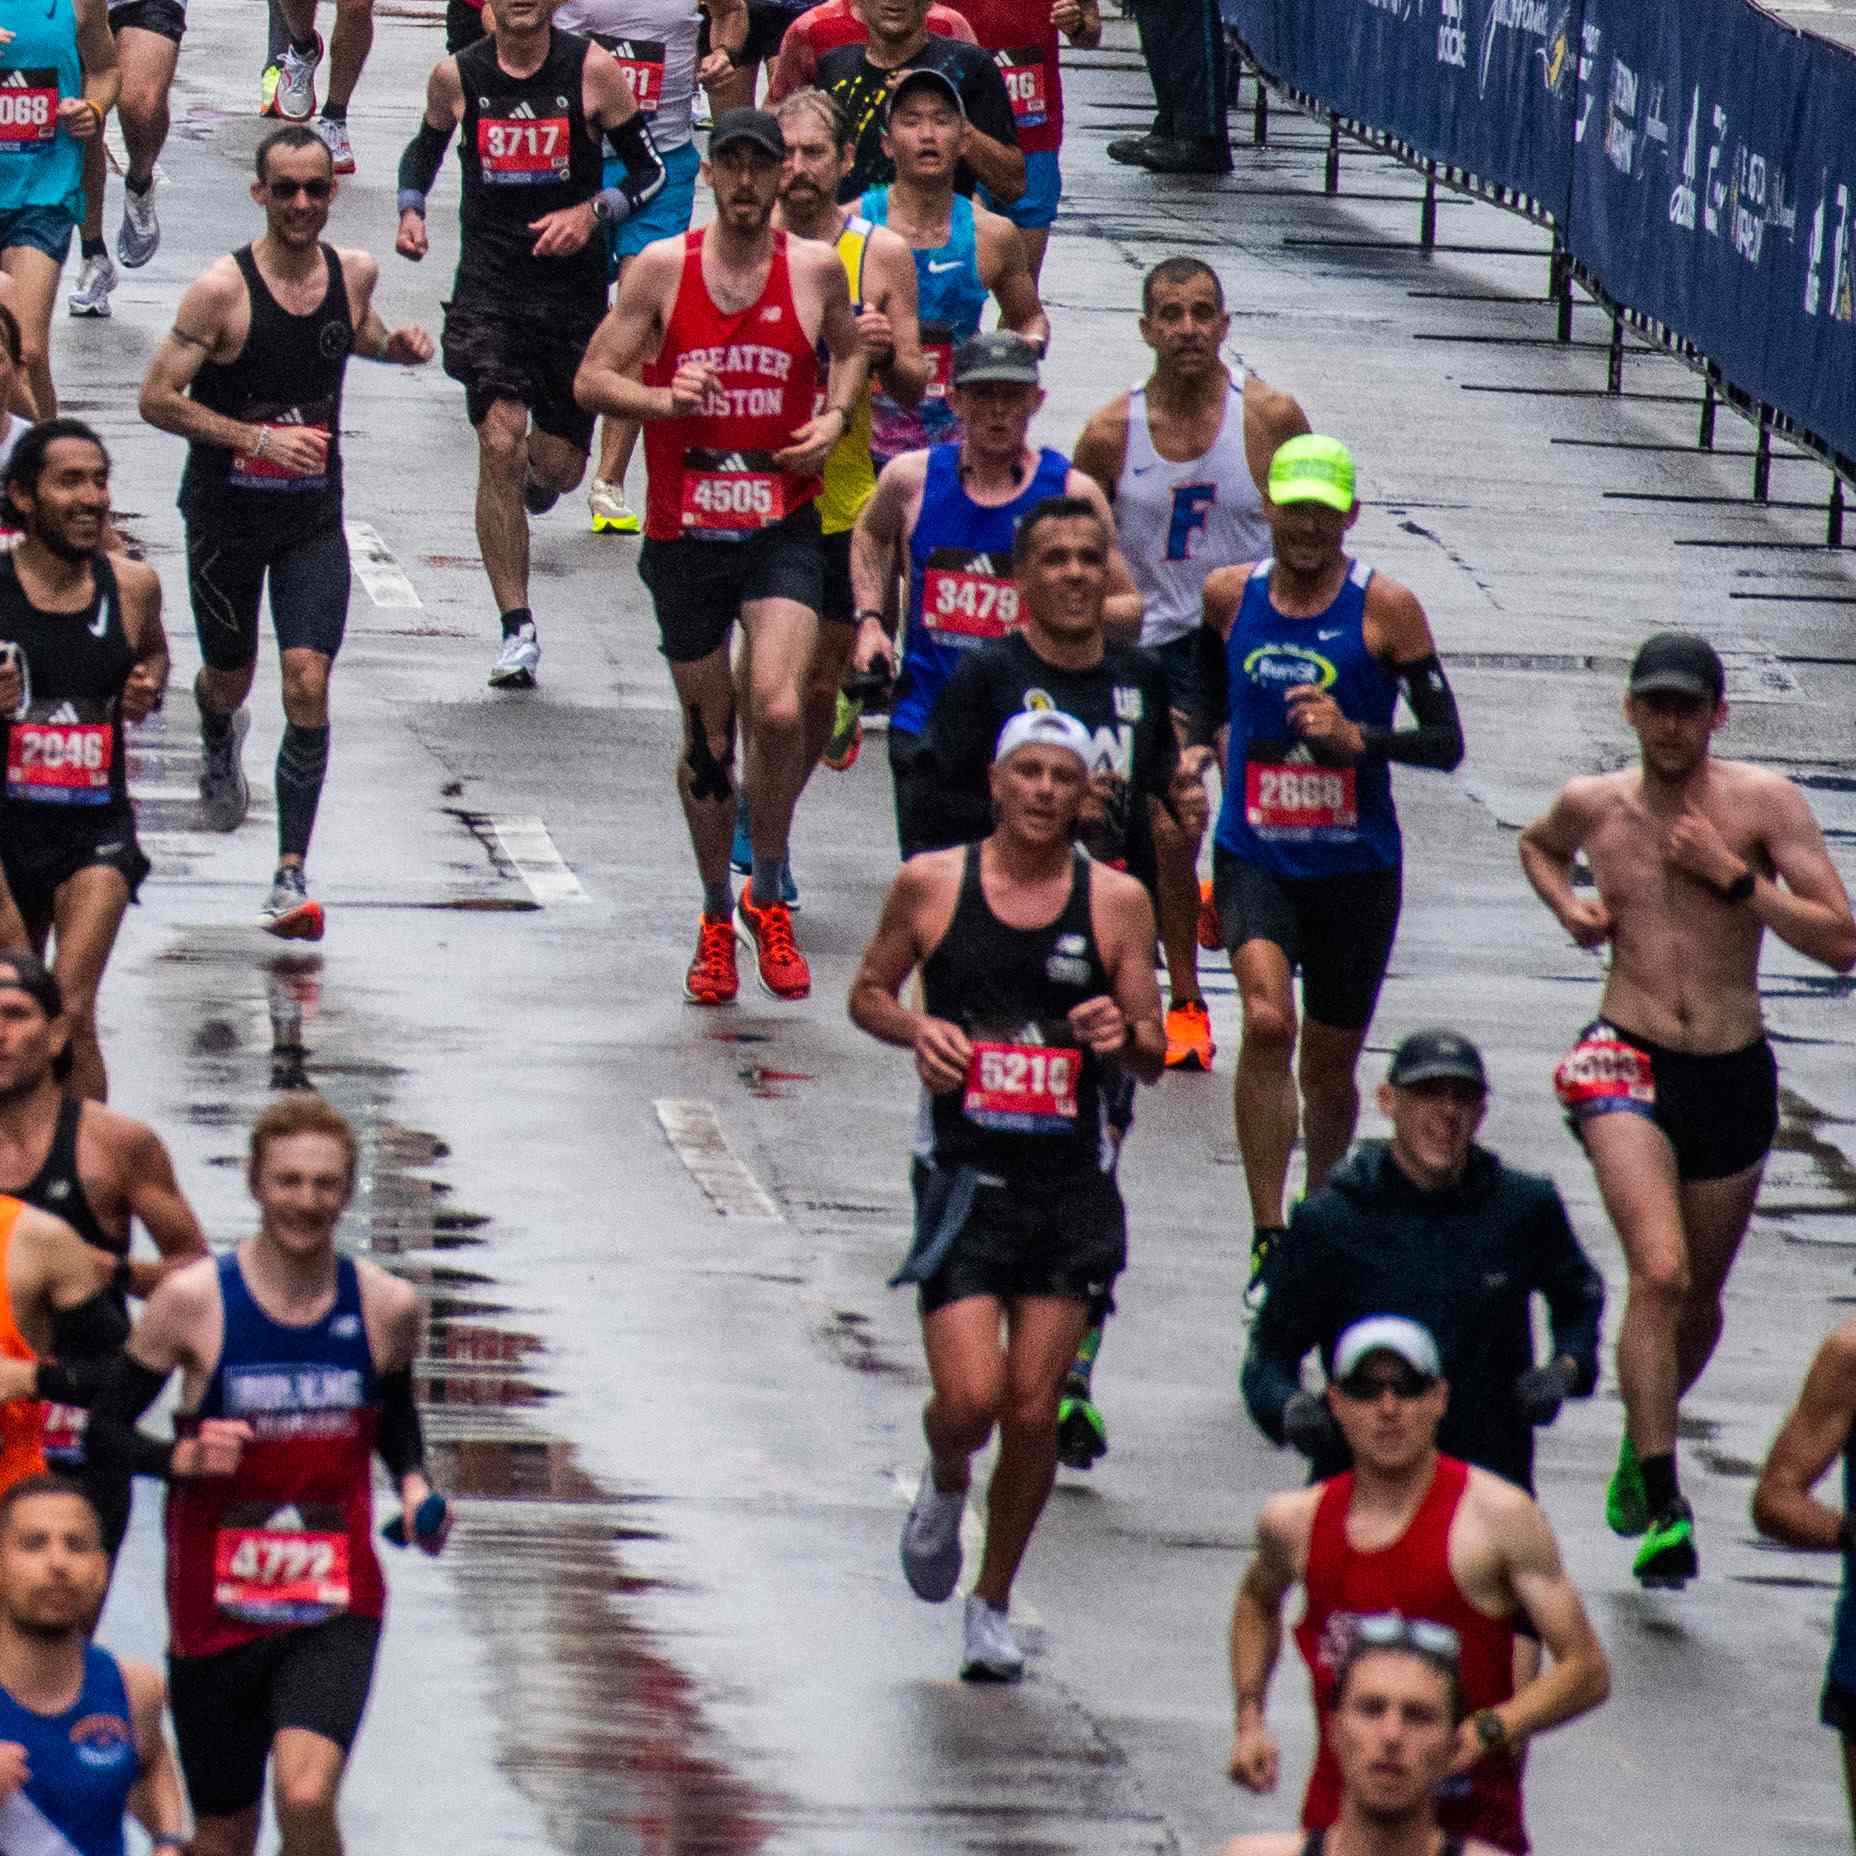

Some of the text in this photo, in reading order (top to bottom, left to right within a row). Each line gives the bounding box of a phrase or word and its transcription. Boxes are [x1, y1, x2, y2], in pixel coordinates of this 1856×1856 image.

[489, 127, 560, 156] 3717
[688, 389, 784, 420] OSTON
[694, 481, 771, 515] 4505
[936, 579, 1019, 620] 3479
